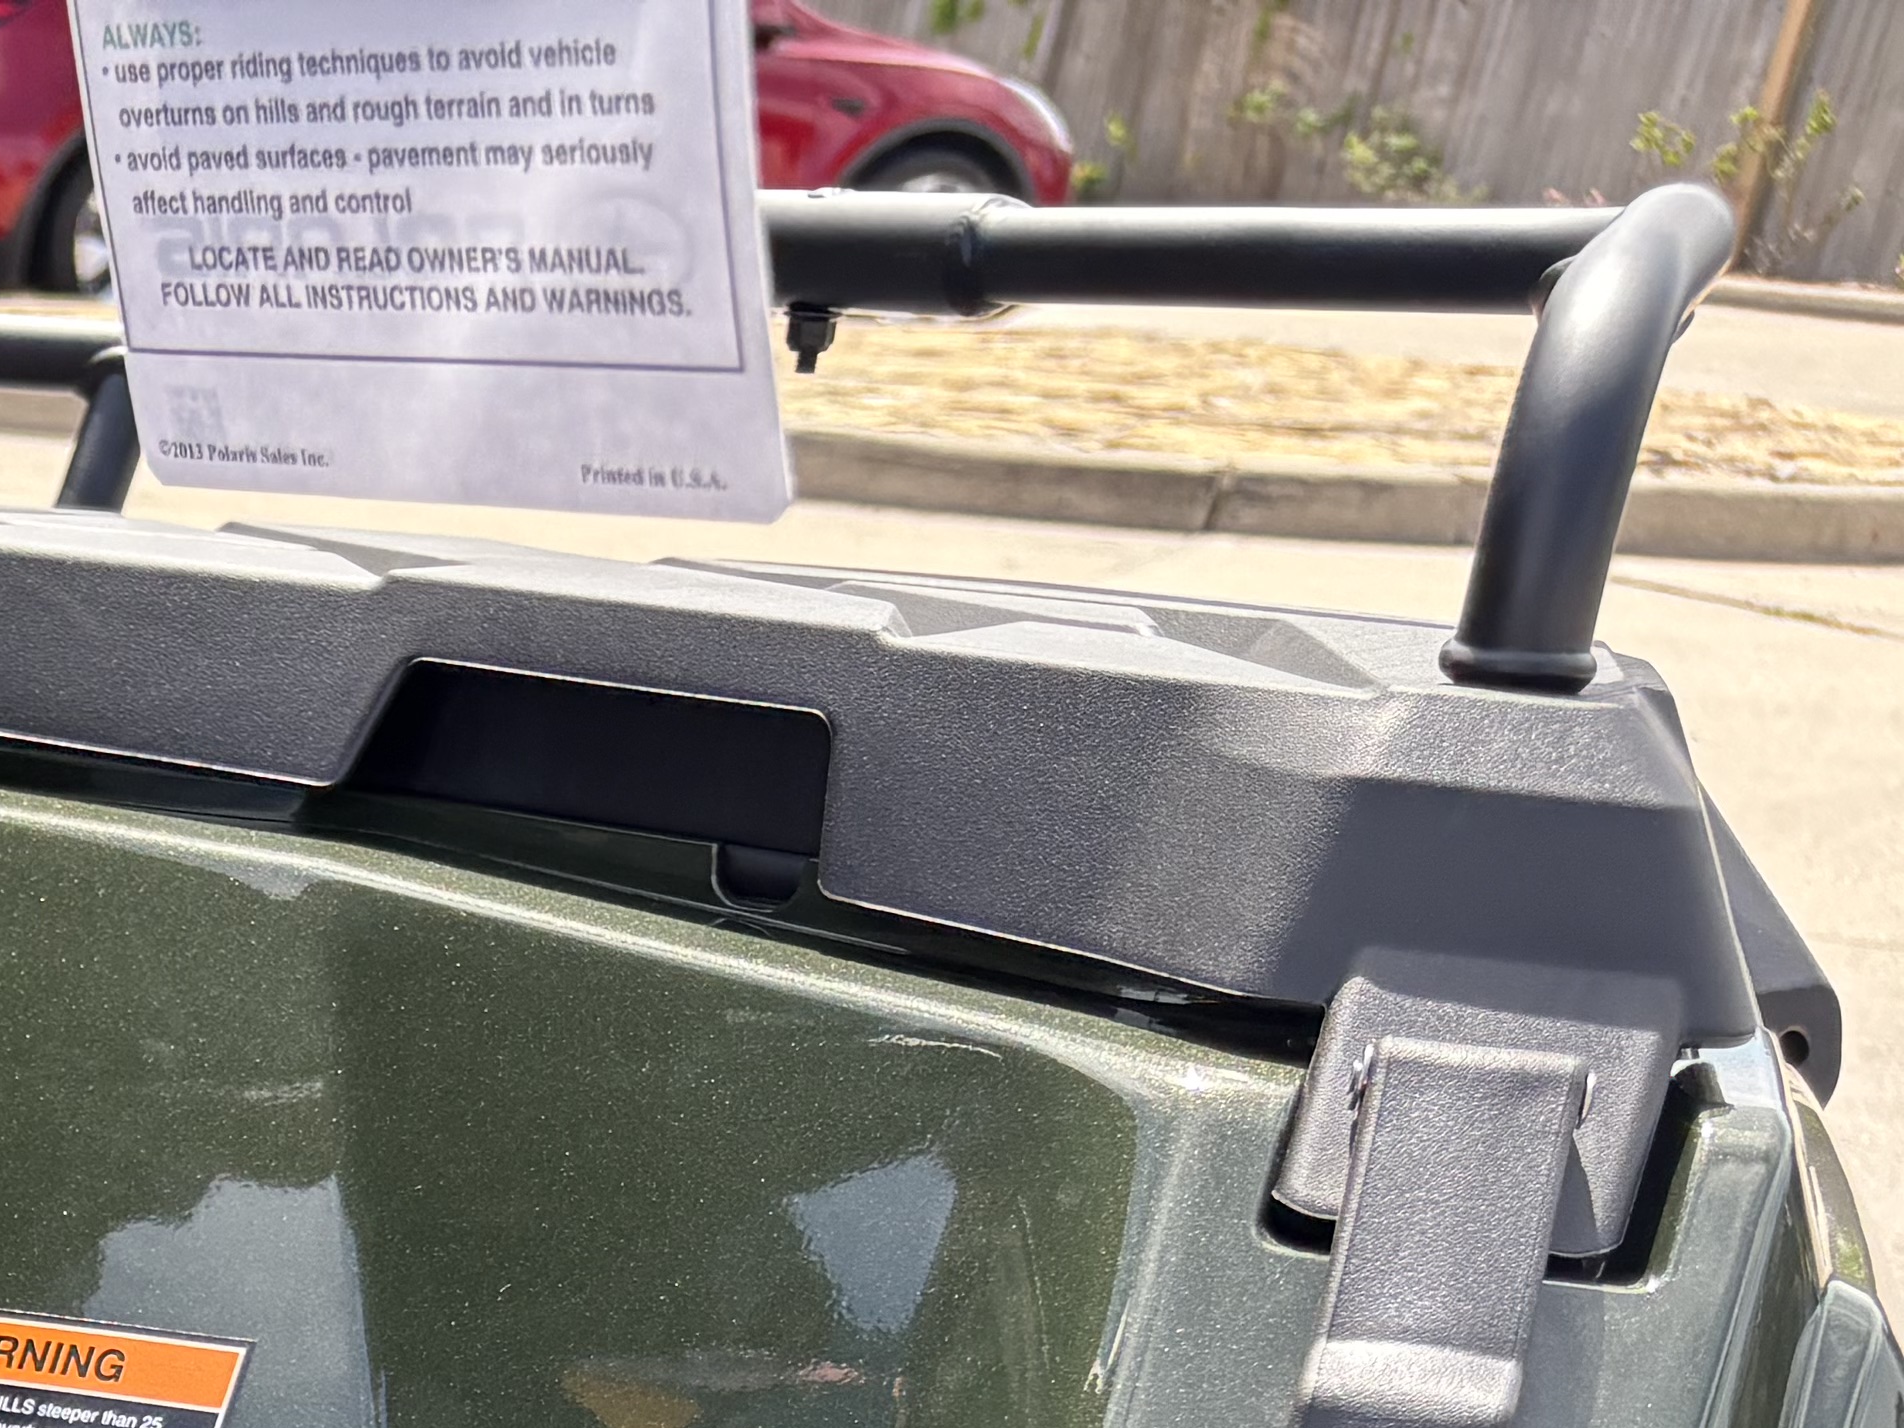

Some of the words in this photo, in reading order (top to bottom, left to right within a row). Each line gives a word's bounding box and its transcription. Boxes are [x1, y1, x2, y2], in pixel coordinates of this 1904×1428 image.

[102, 20, 203, 50] ALWAYS:
[115, 62, 150, 83] use
[157, 60, 224, 88] proper
[231, 53, 292, 84] riding
[298, 48, 422, 82] techniques
[428, 47, 450, 72] to
[458, 40, 522, 70] avoid
[528, 38, 616, 67] vehicle
[119, 104, 217, 128] overturns
[223, 104, 249, 126] on
[255, 97, 300, 124] hills
[306, 96, 346, 123] and
[353, 95, 419, 127] rough
[425, 91, 501, 120] terrain
[509, 89, 552, 118] and
[560, 88, 582, 117] in
[590, 89, 655, 116] turns
[128, 146, 181, 172] avoid
[188, 144, 248, 176] paved
[256, 144, 347, 171] surfaces
[368, 142, 478, 174] pavement
[485, 142, 533, 173] may
[542, 137, 653, 172] seriously
[133, 190, 188, 215] affect
[192, 188, 282, 221] handling
[291, 189, 328, 214] and
[335, 188, 412, 214] control
[189, 246, 277, 271] LOCATE
[283, 246, 330, 272] AND
[337, 247, 401, 273] READ
[407, 246, 522, 274] OWNER'S
[161, 282, 249, 307] FOLLOW
[259, 284, 301, 308] ALL
[305, 284, 478, 312] INSTRUCTIONS
[485, 286, 536, 313] AND
[542, 287, 692, 317] WARNINGS.
[207, 443, 258, 463] Polaris
[261, 447, 298, 465] Sales
[301, 449, 330, 467] Inc.
[581, 464, 644, 487] Printed
[36, 1402, 99, 1423] steeper
[100, 1409, 138, 1428] than
